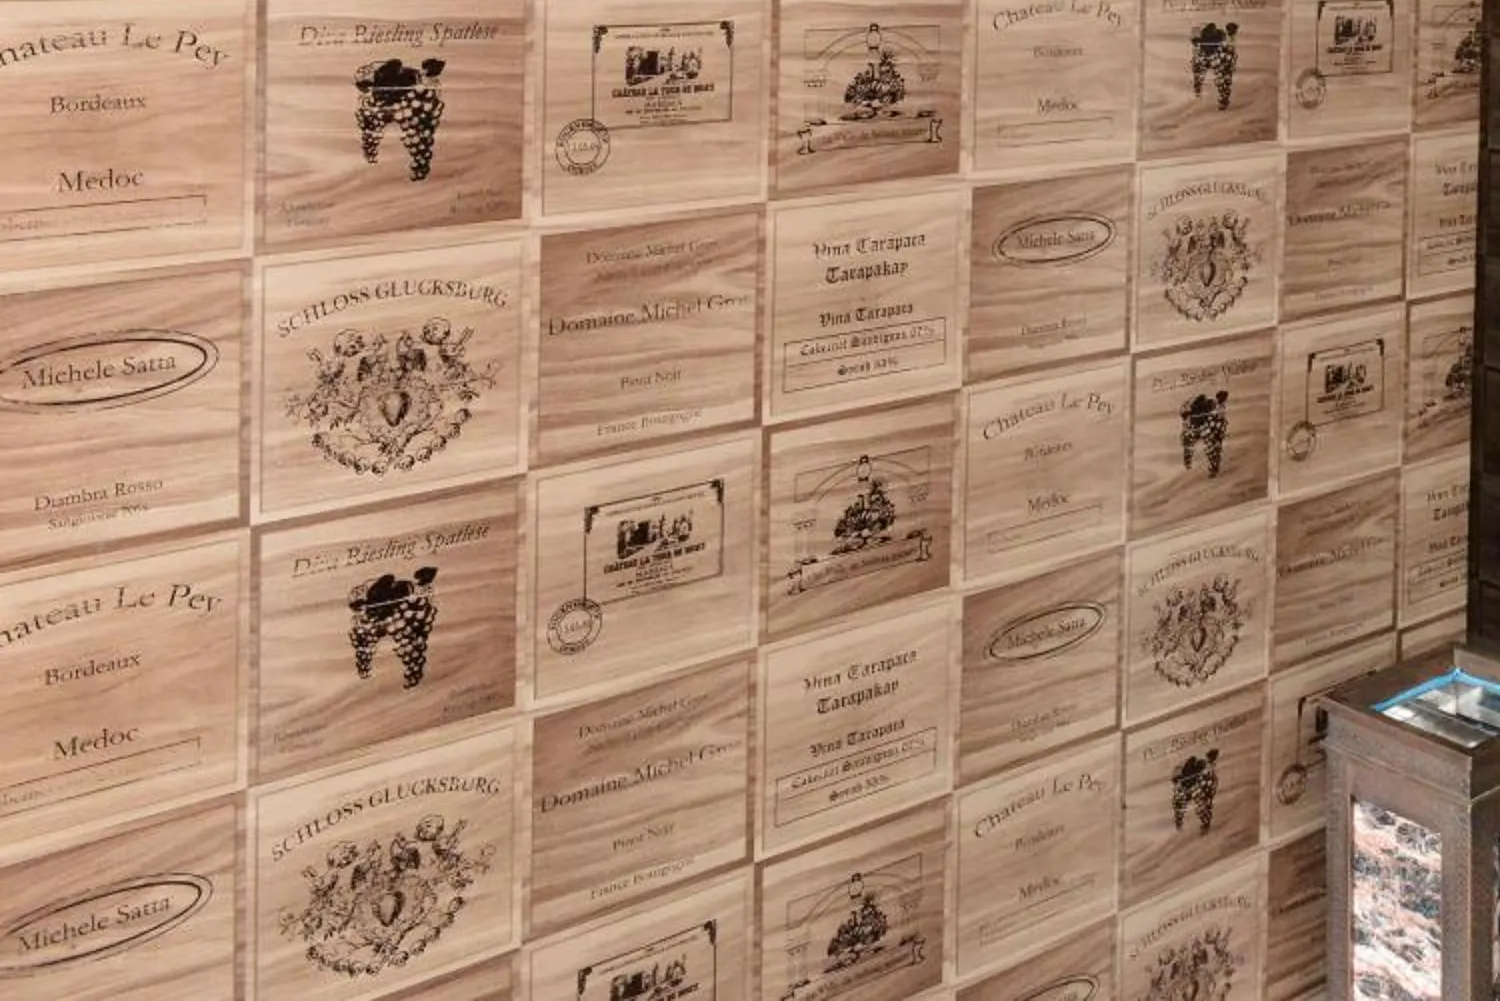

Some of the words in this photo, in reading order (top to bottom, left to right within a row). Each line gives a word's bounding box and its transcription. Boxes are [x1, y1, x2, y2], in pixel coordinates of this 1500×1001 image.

[122, 22, 162, 49] Le
[353, 23, 424, 47] Riesling
[431, 21, 498, 48] Spatlese
[51, 93, 146, 114] Bordeaux
[59, 168, 144, 192] Medoc
[278, 284, 370, 339] SCHLOSS
[375, 278, 510, 308] GLUCKSBURG
[22, 360, 115, 388] Michele
[121, 356, 176, 376] Satta
[983, 399, 1055, 440] Chateau
[345, 535, 416, 566] Riesling
[420, 524, 491, 554] Spatlese
[114, 586, 155, 609] Le
[44, 653, 141, 686] Bordeaux
[54, 727, 140, 760] Medoc
[272, 796, 363, 861] SCHLOSS
[369, 776, 499, 808] GLUCKSBURG
[18, 913, 109, 952] Michele
[116, 896, 171, 924] Satta
